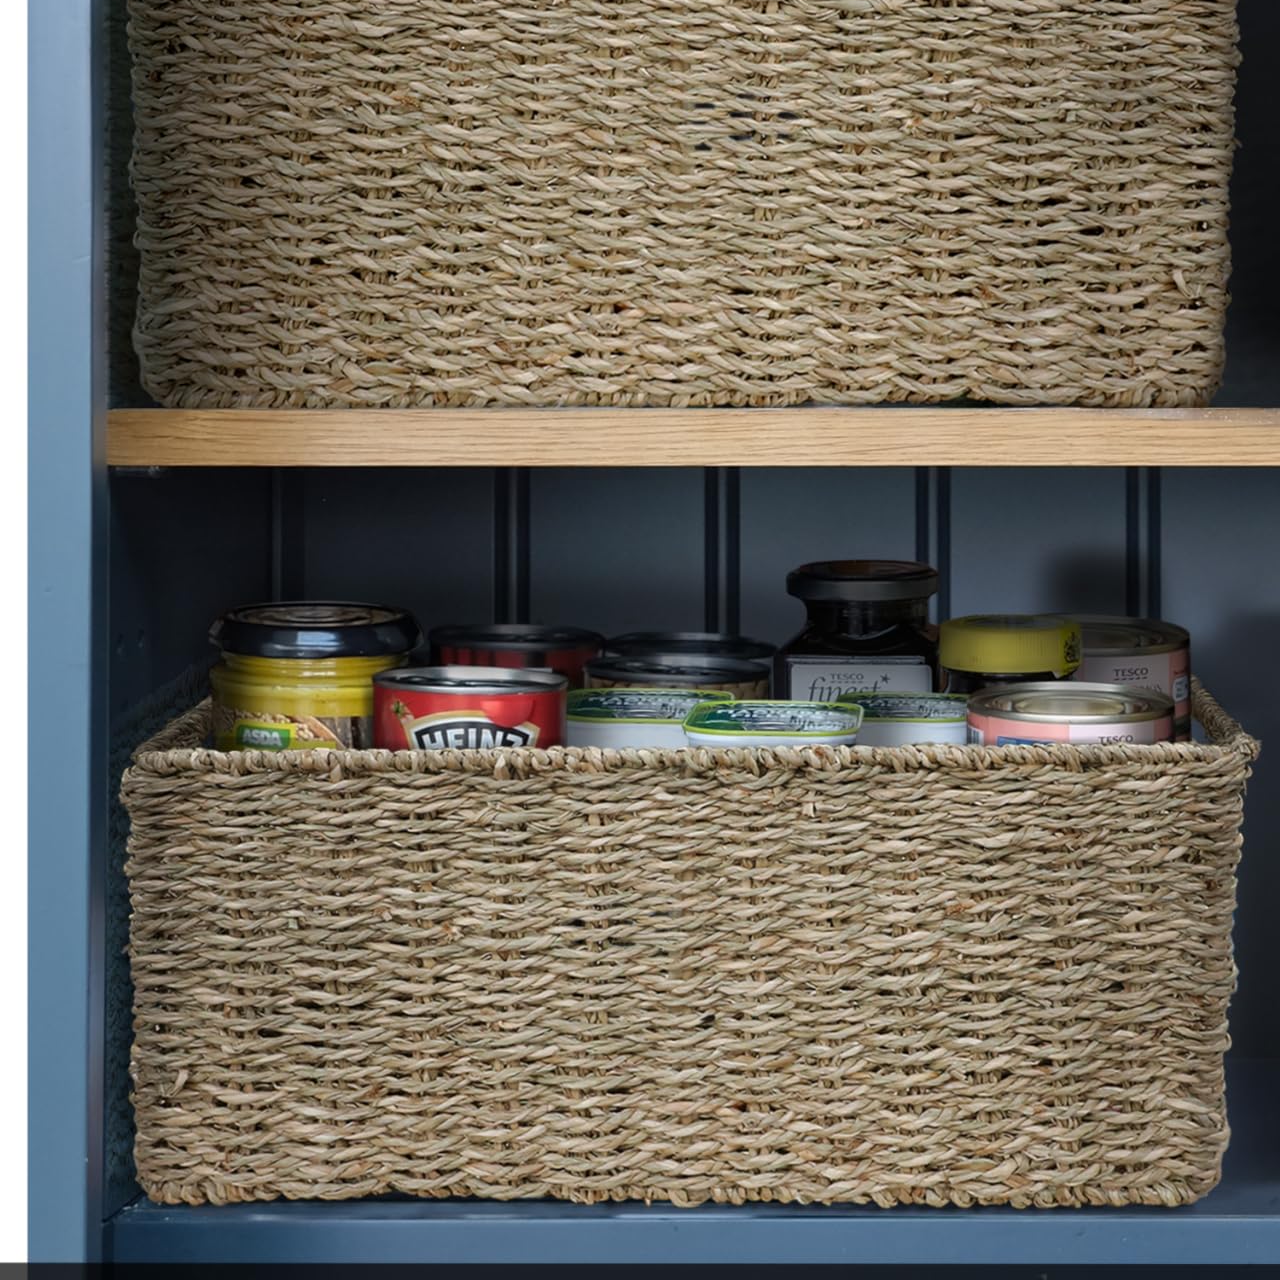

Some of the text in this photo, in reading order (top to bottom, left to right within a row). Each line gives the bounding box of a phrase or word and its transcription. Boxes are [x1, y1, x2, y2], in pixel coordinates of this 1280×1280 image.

[829, 672, 865, 681] TESCO
[1113, 667, 1149, 677] TESCO
[241, 728, 283, 747] ASDA
[1097, 734, 1134, 744] TESCO
